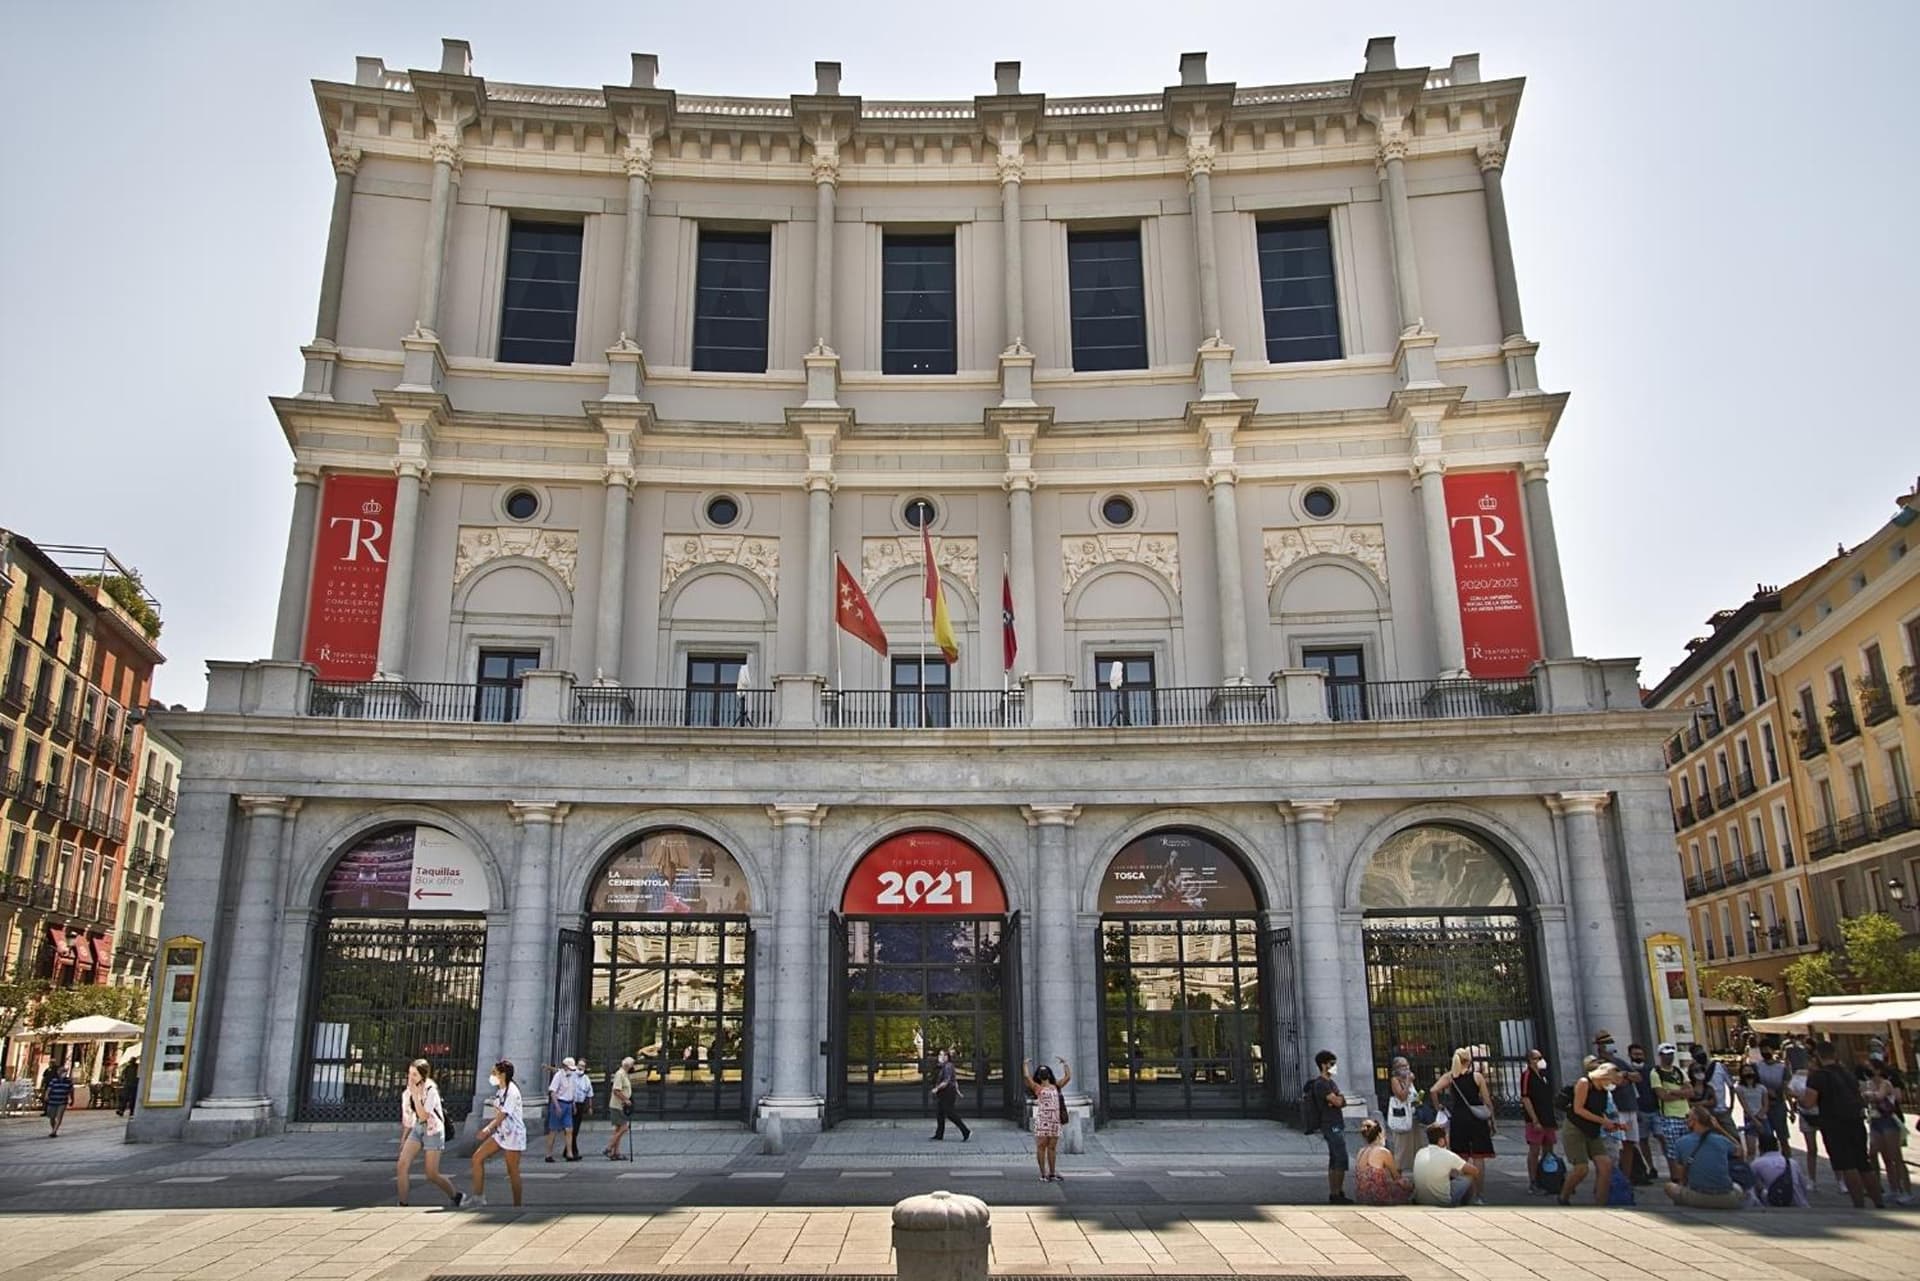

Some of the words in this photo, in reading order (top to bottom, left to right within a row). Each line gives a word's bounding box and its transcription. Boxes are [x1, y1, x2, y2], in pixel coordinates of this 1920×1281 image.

[330, 517, 387, 562] TR
[1451, 515, 1516, 558] TR
[1460, 578, 1518, 590] 2020/2023
[416, 866, 460, 876] Taquillas
[1114, 872, 1145, 880] TOSCA
[608, 879, 669, 887] CENERENTOLA
[877, 869, 972, 906] 2021
